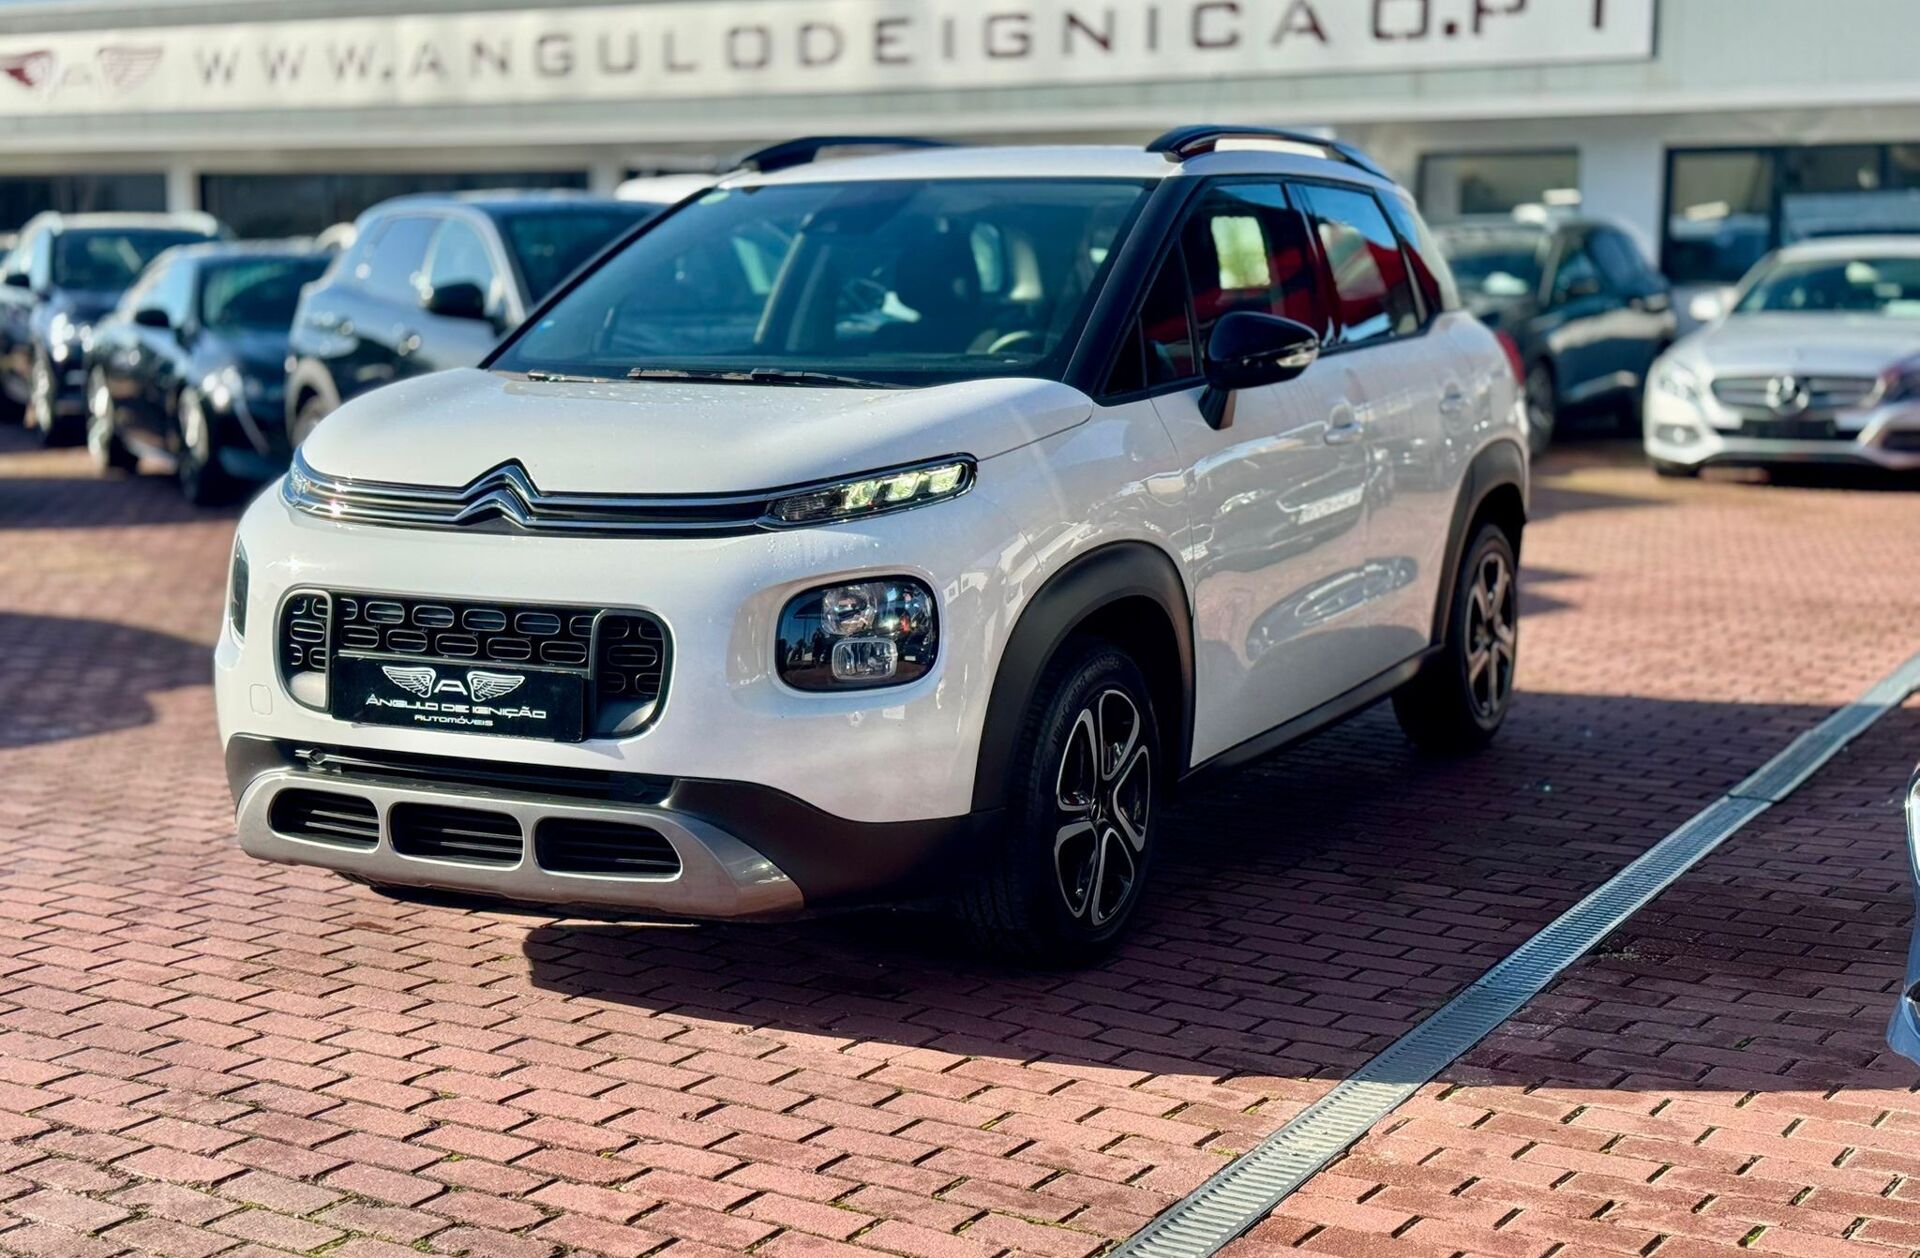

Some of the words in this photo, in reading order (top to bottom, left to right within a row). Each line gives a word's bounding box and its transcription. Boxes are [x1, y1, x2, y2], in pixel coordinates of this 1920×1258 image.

[441, 703, 470, 713] DE
[472, 706, 547, 719] IGNIÇÃO
[414, 714, 494, 726] AUTOMÓVEIS
